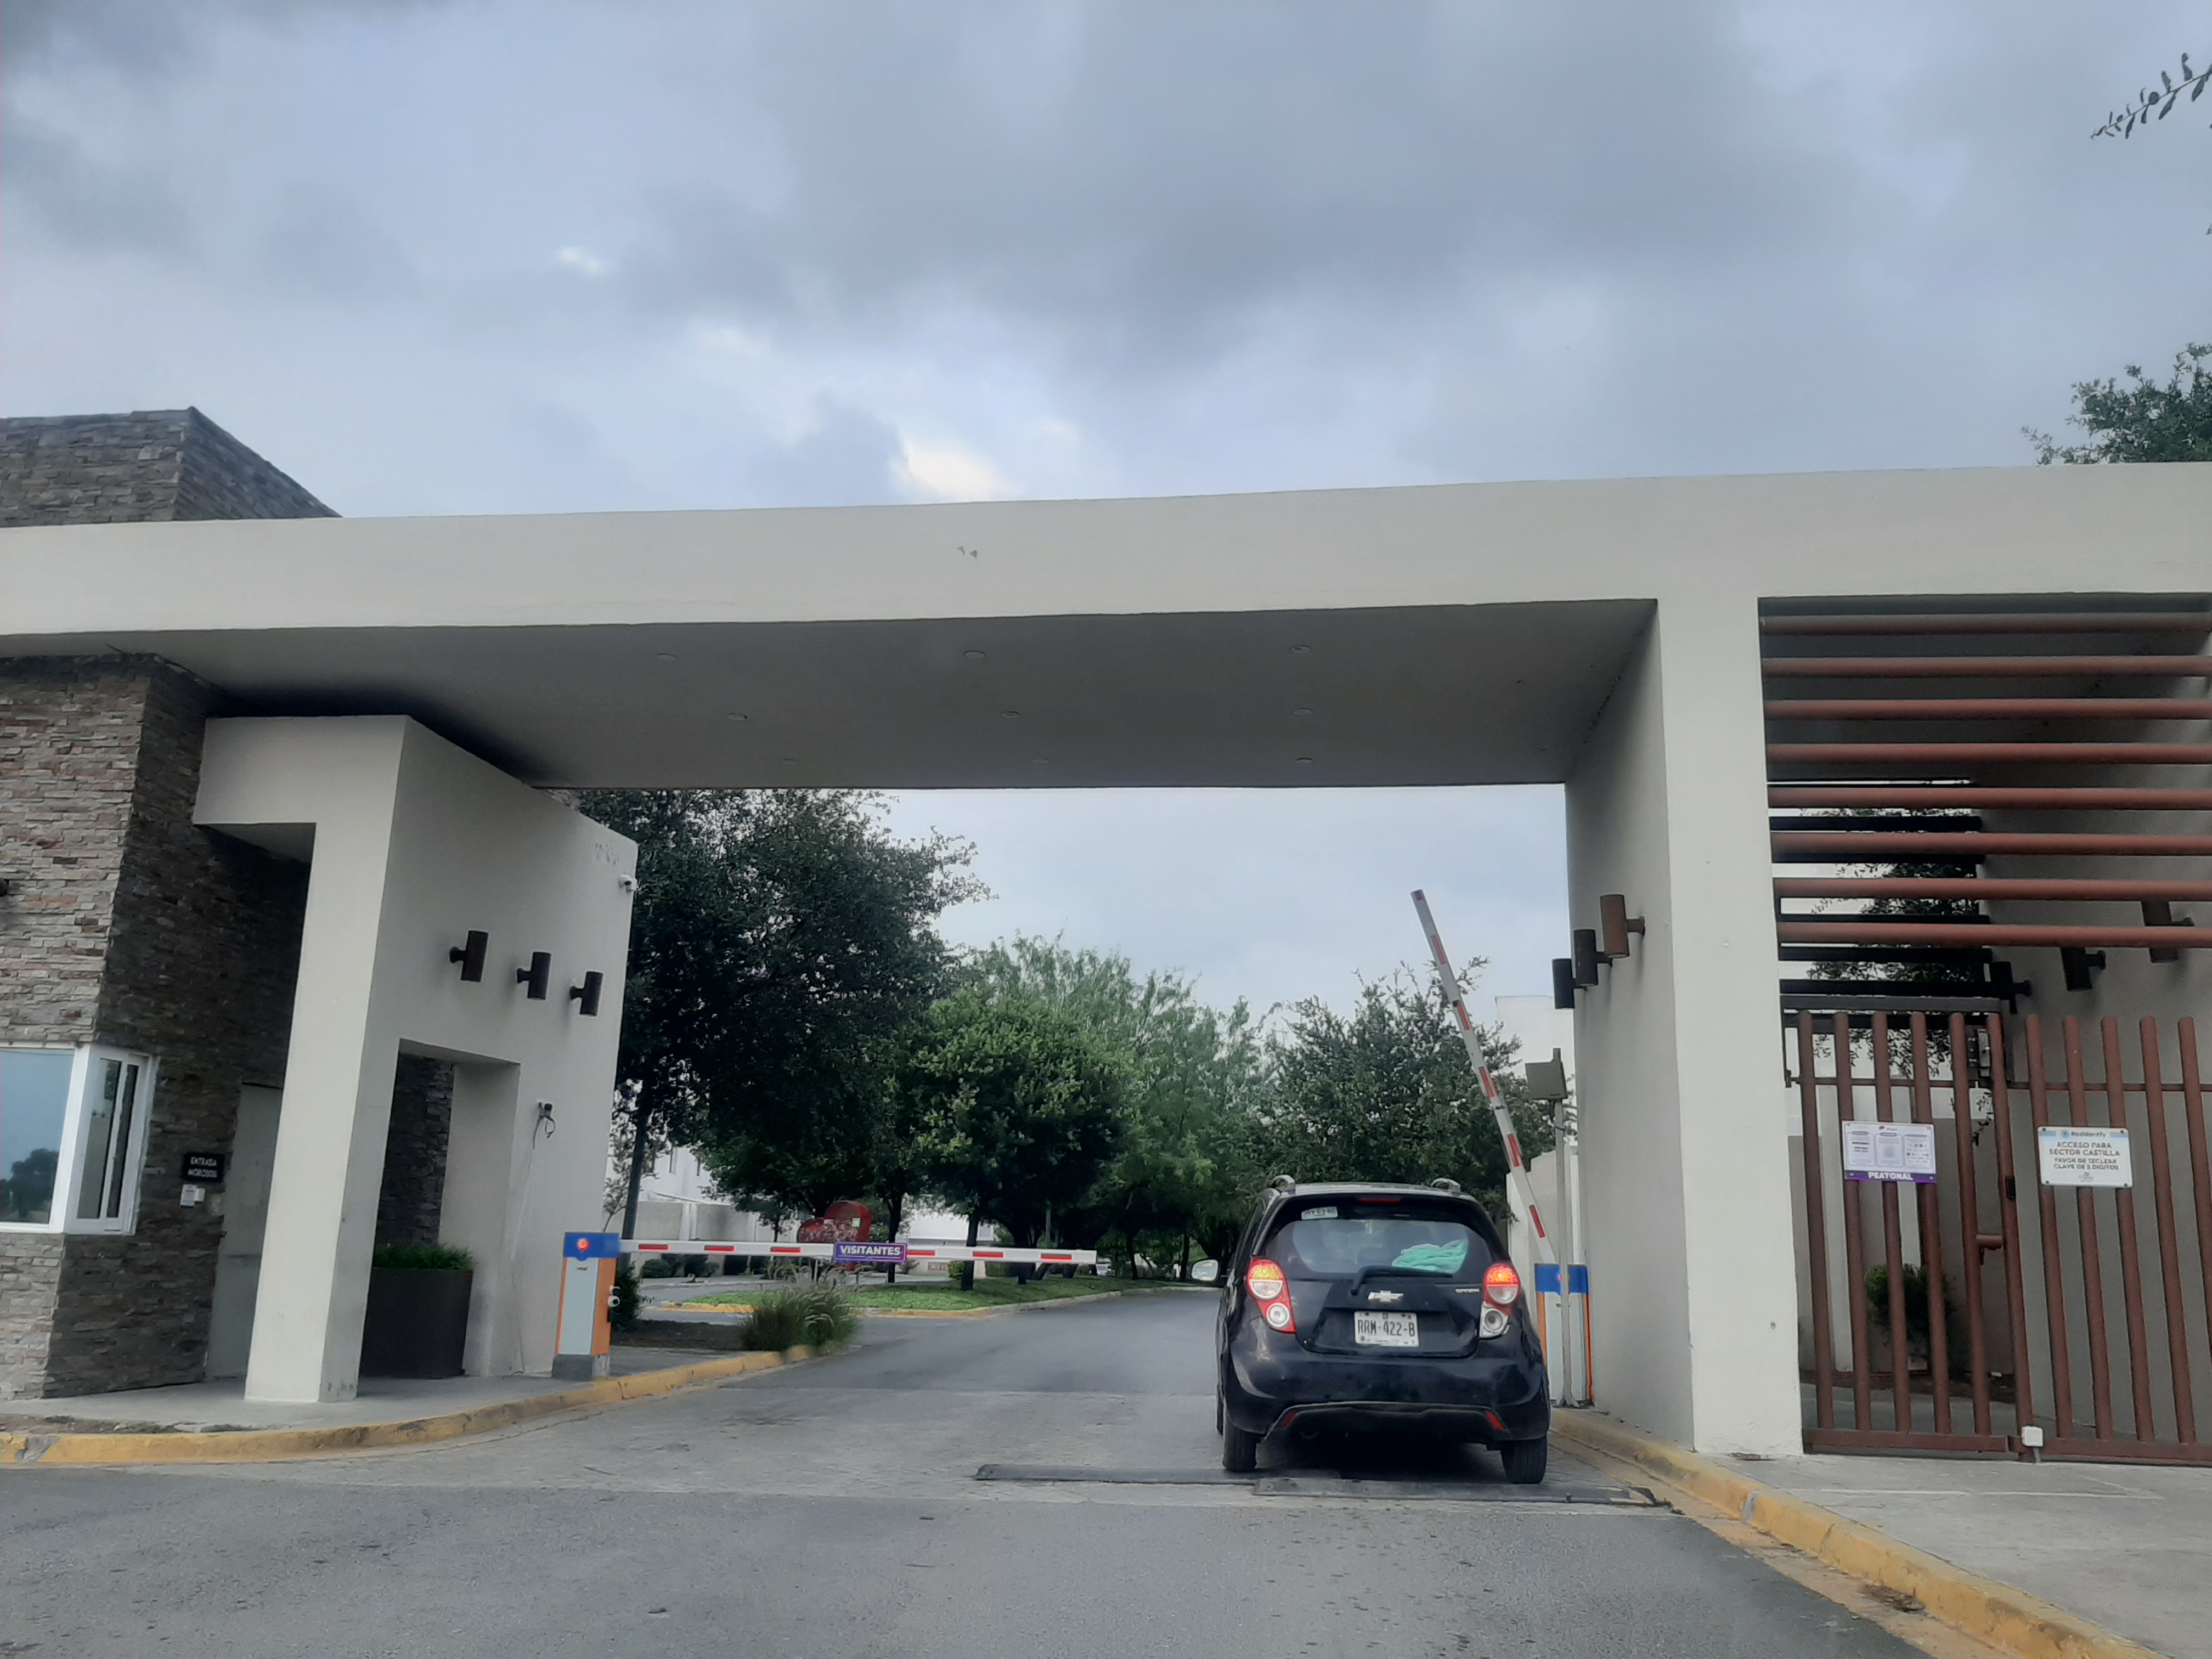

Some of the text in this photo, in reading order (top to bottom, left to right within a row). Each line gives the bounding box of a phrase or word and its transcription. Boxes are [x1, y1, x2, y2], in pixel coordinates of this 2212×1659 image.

[190, 1156, 217, 1166] ENTRADA
[1867, 1171, 1914, 1181] PEATONAL
[840, 1245, 901, 1256] VISITANTES
